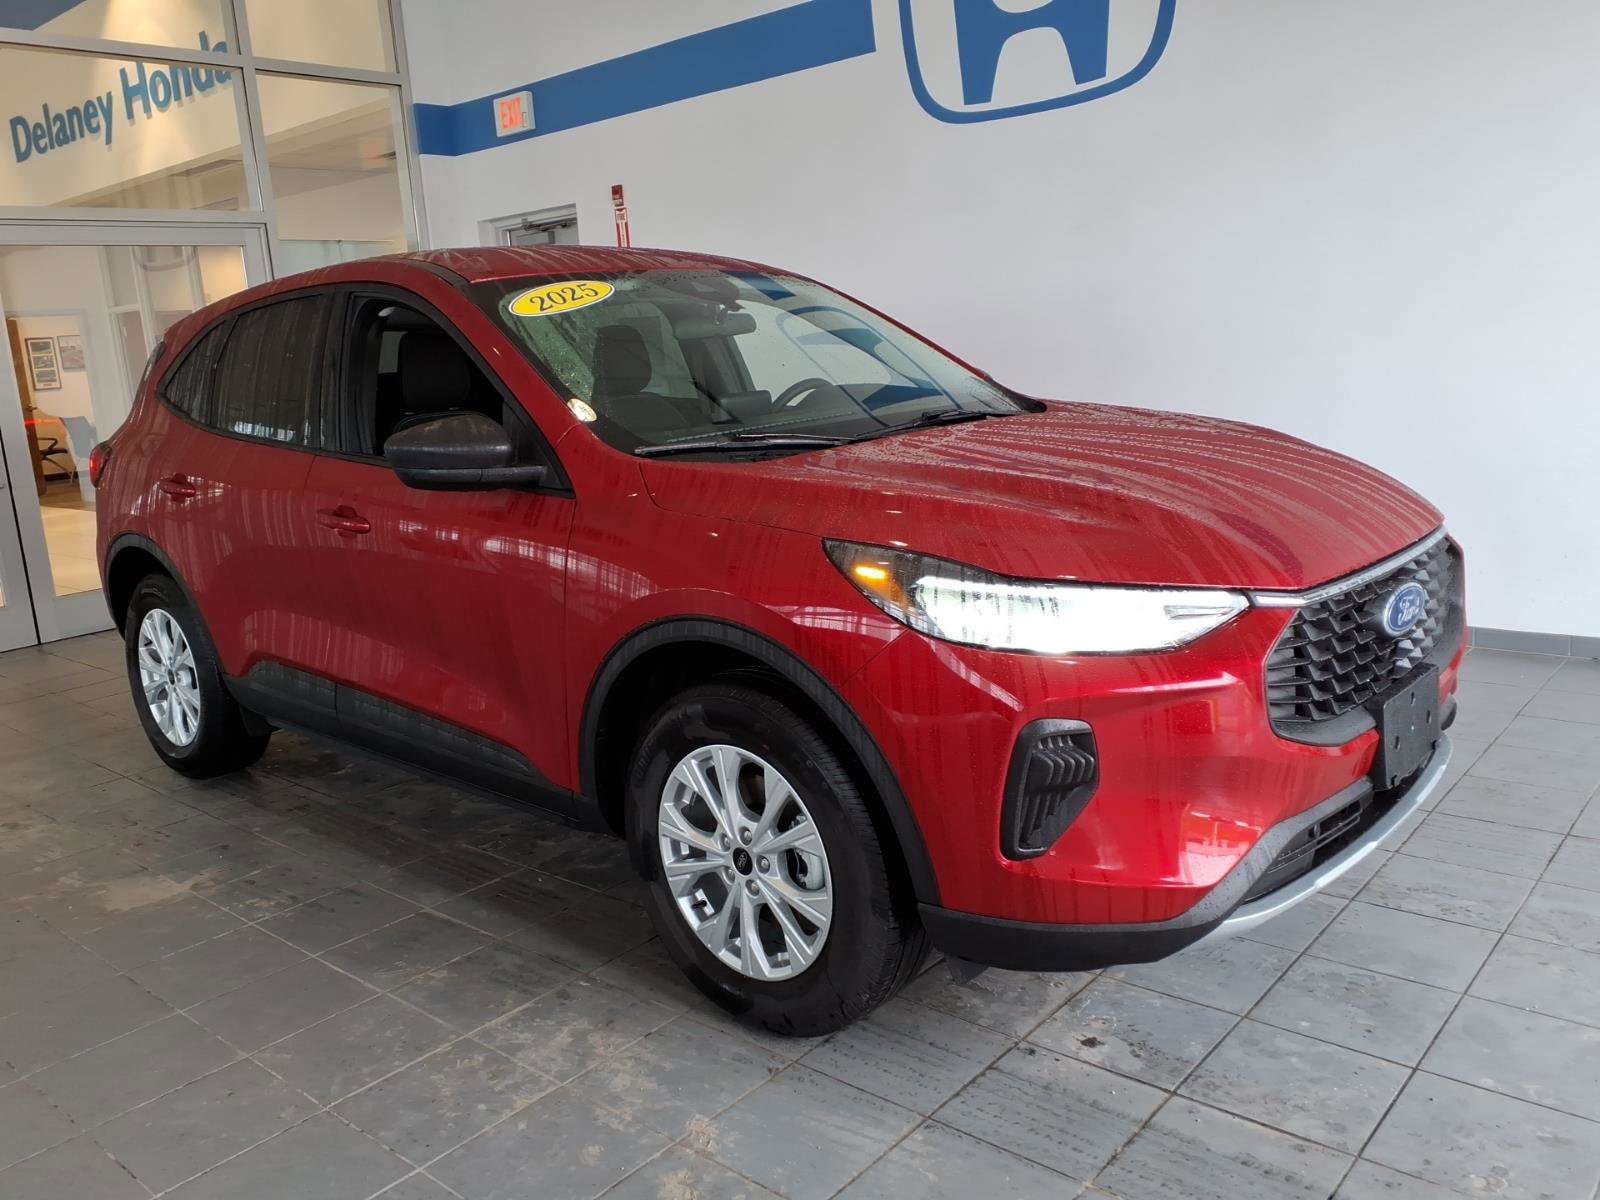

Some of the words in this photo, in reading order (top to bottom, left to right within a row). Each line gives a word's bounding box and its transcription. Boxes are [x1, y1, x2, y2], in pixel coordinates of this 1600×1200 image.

[10, 91, 113, 163] Delaney
[499, 96, 522, 129] EXIT
[529, 283, 599, 312] 2025
[1397, 594, 1420, 626] Ford
